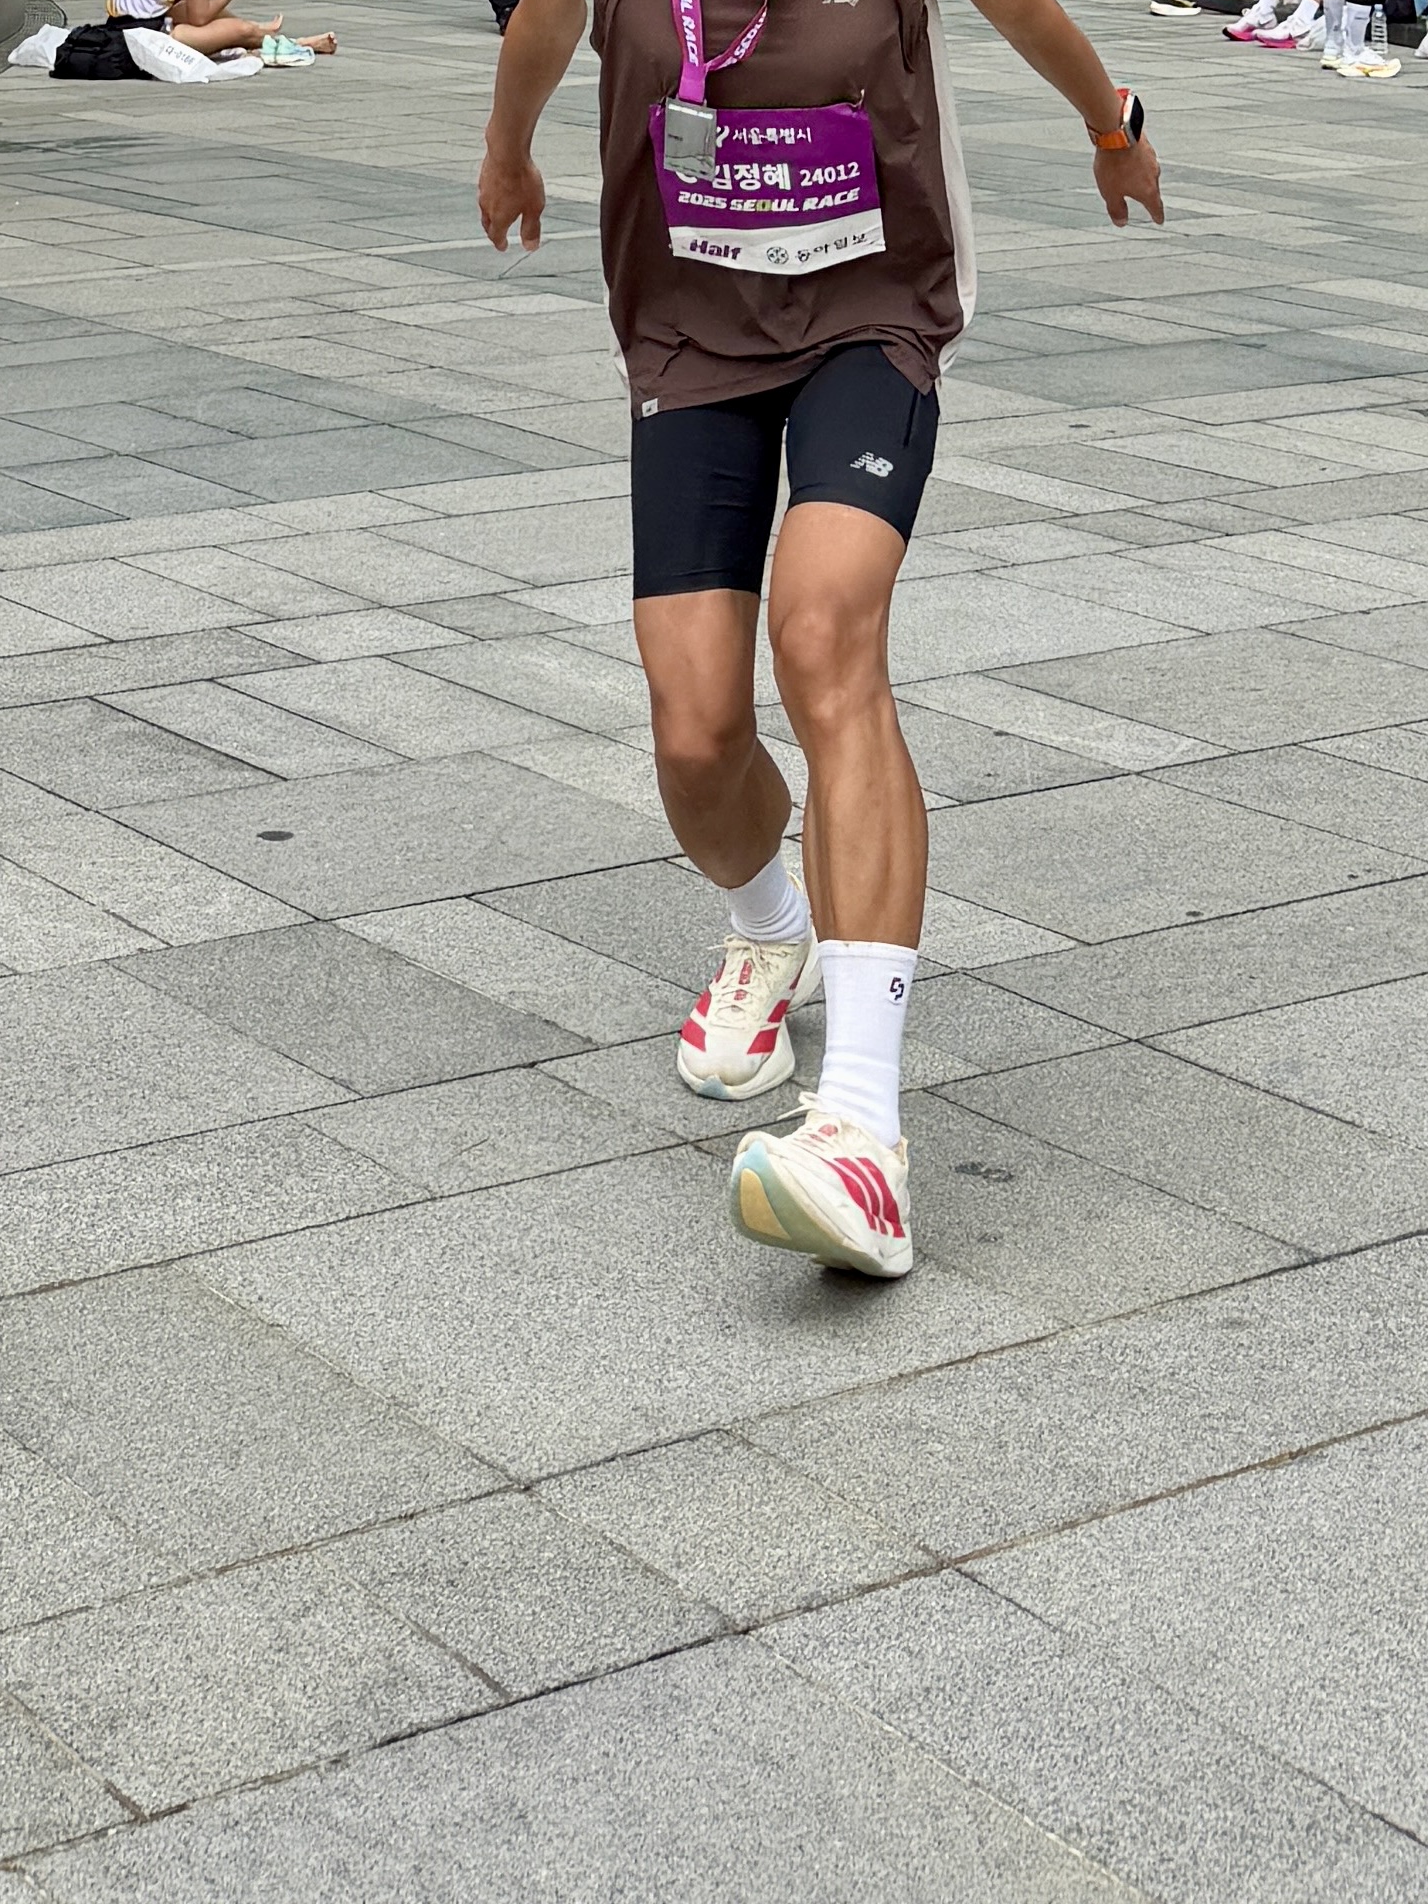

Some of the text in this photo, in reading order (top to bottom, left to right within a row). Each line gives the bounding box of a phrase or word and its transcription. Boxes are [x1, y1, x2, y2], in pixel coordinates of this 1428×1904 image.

[681, 15, 699, 67] RACE
[732, 127, 812, 145] 서울특별시
[799, 161, 861, 187] 24012
[677, 187, 861, 212] 2025 SEOUL RACE
[689, 238, 743, 260] Half
[796, 233, 868, 263] 동아일보
